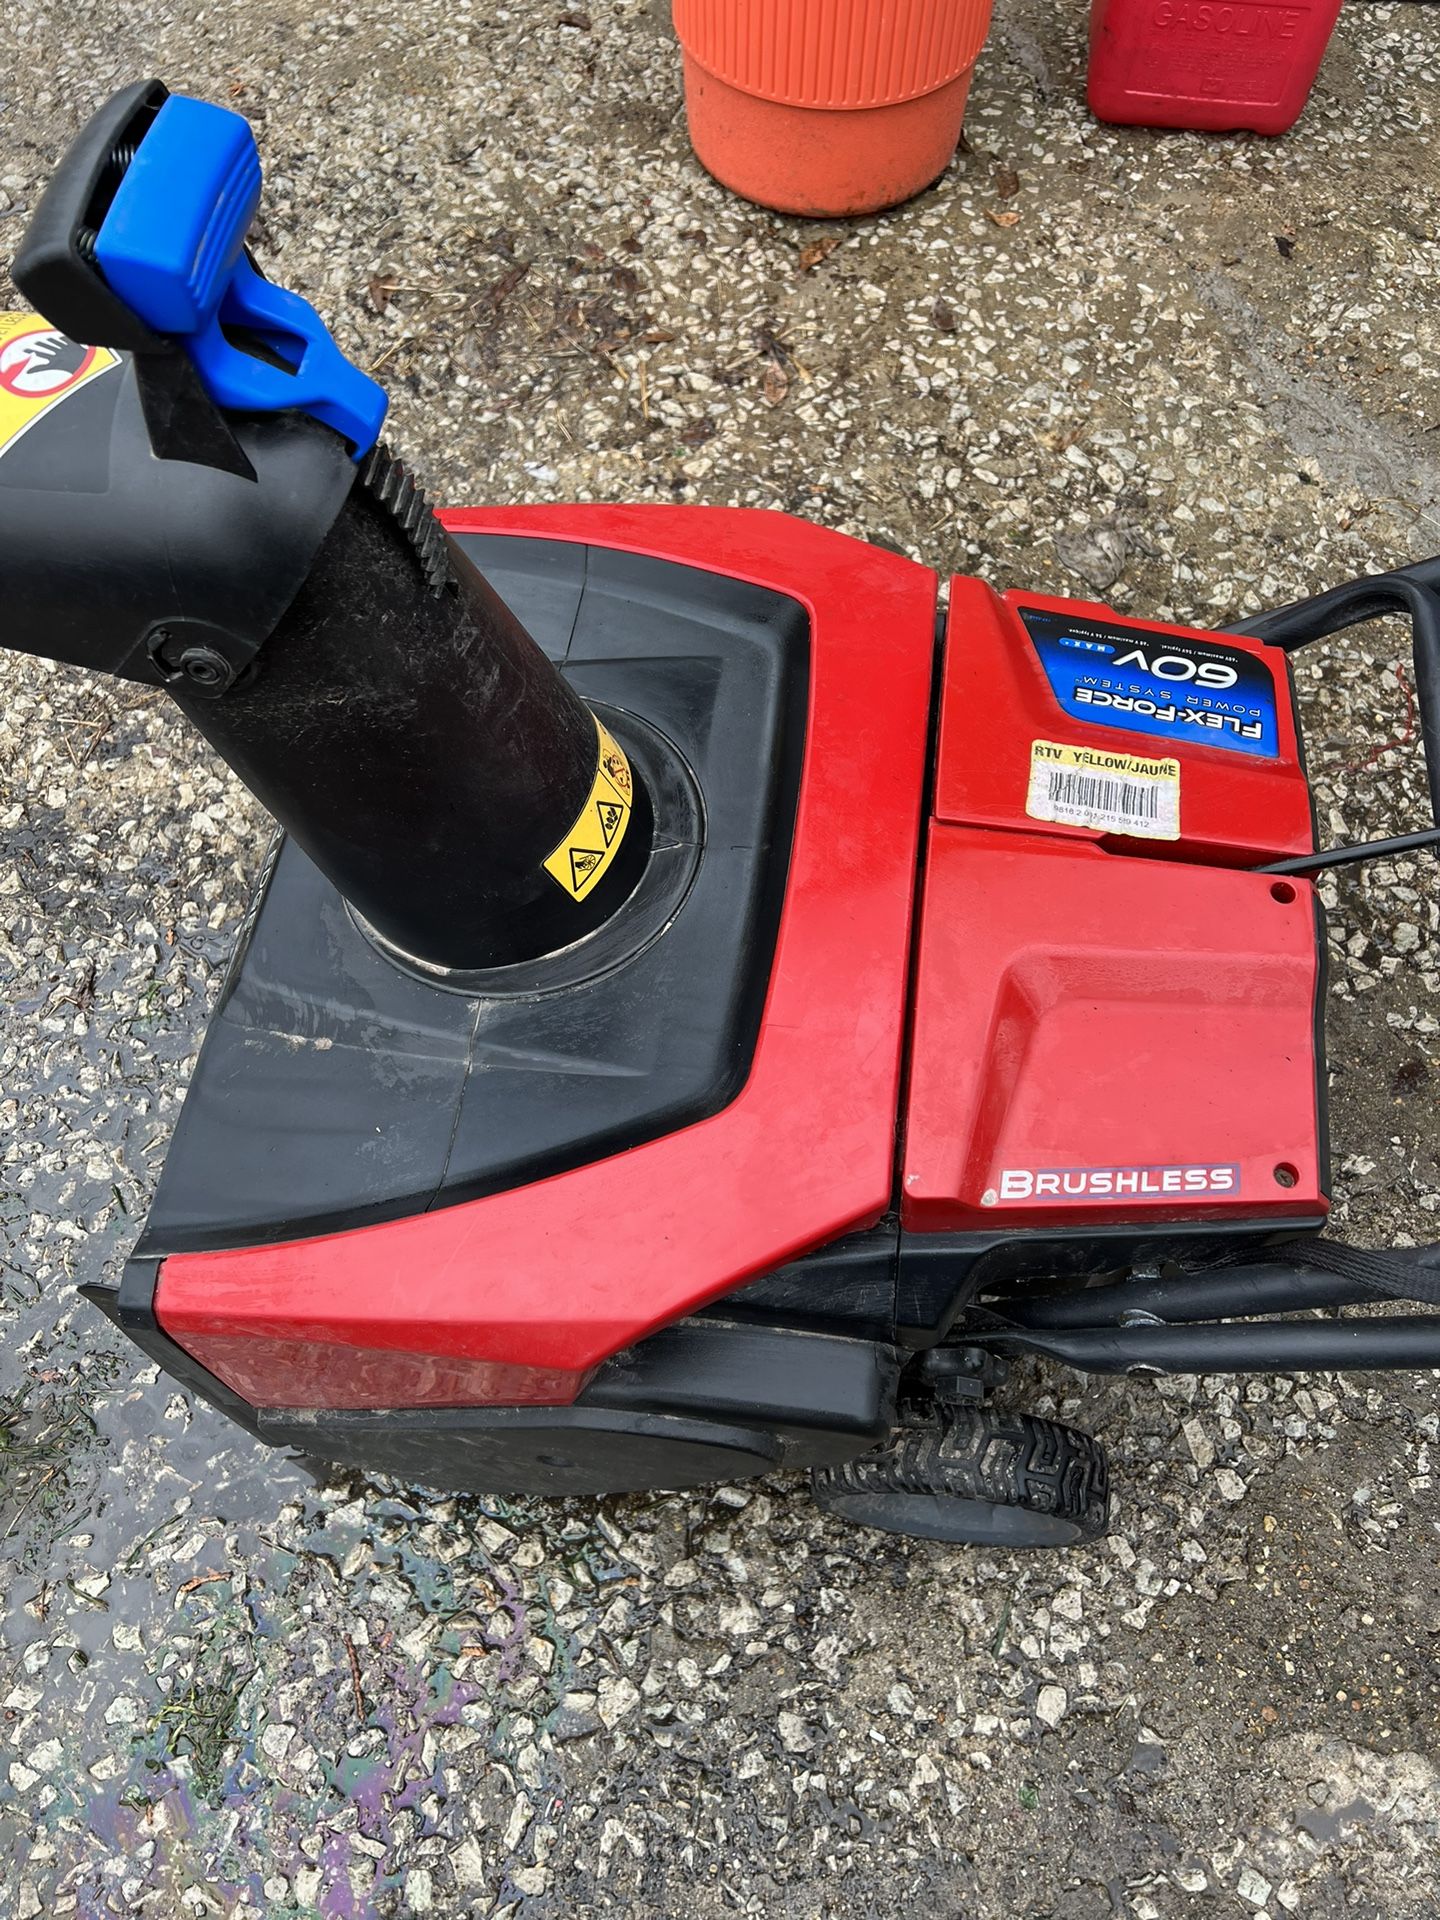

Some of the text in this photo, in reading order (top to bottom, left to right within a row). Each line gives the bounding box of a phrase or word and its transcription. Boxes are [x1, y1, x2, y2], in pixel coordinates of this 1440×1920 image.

[1154, 1, 1300, 37] GASOLINE
[1112, 649, 1238, 689] 60V
[1074, 687, 1263, 739] FLEX-FORCE
[1186, 695, 1262, 717] POWER
[1034, 746, 1177, 777] RTV YELLOW/JAUNE
[999, 1168, 1234, 1199] BRUSHLESS
